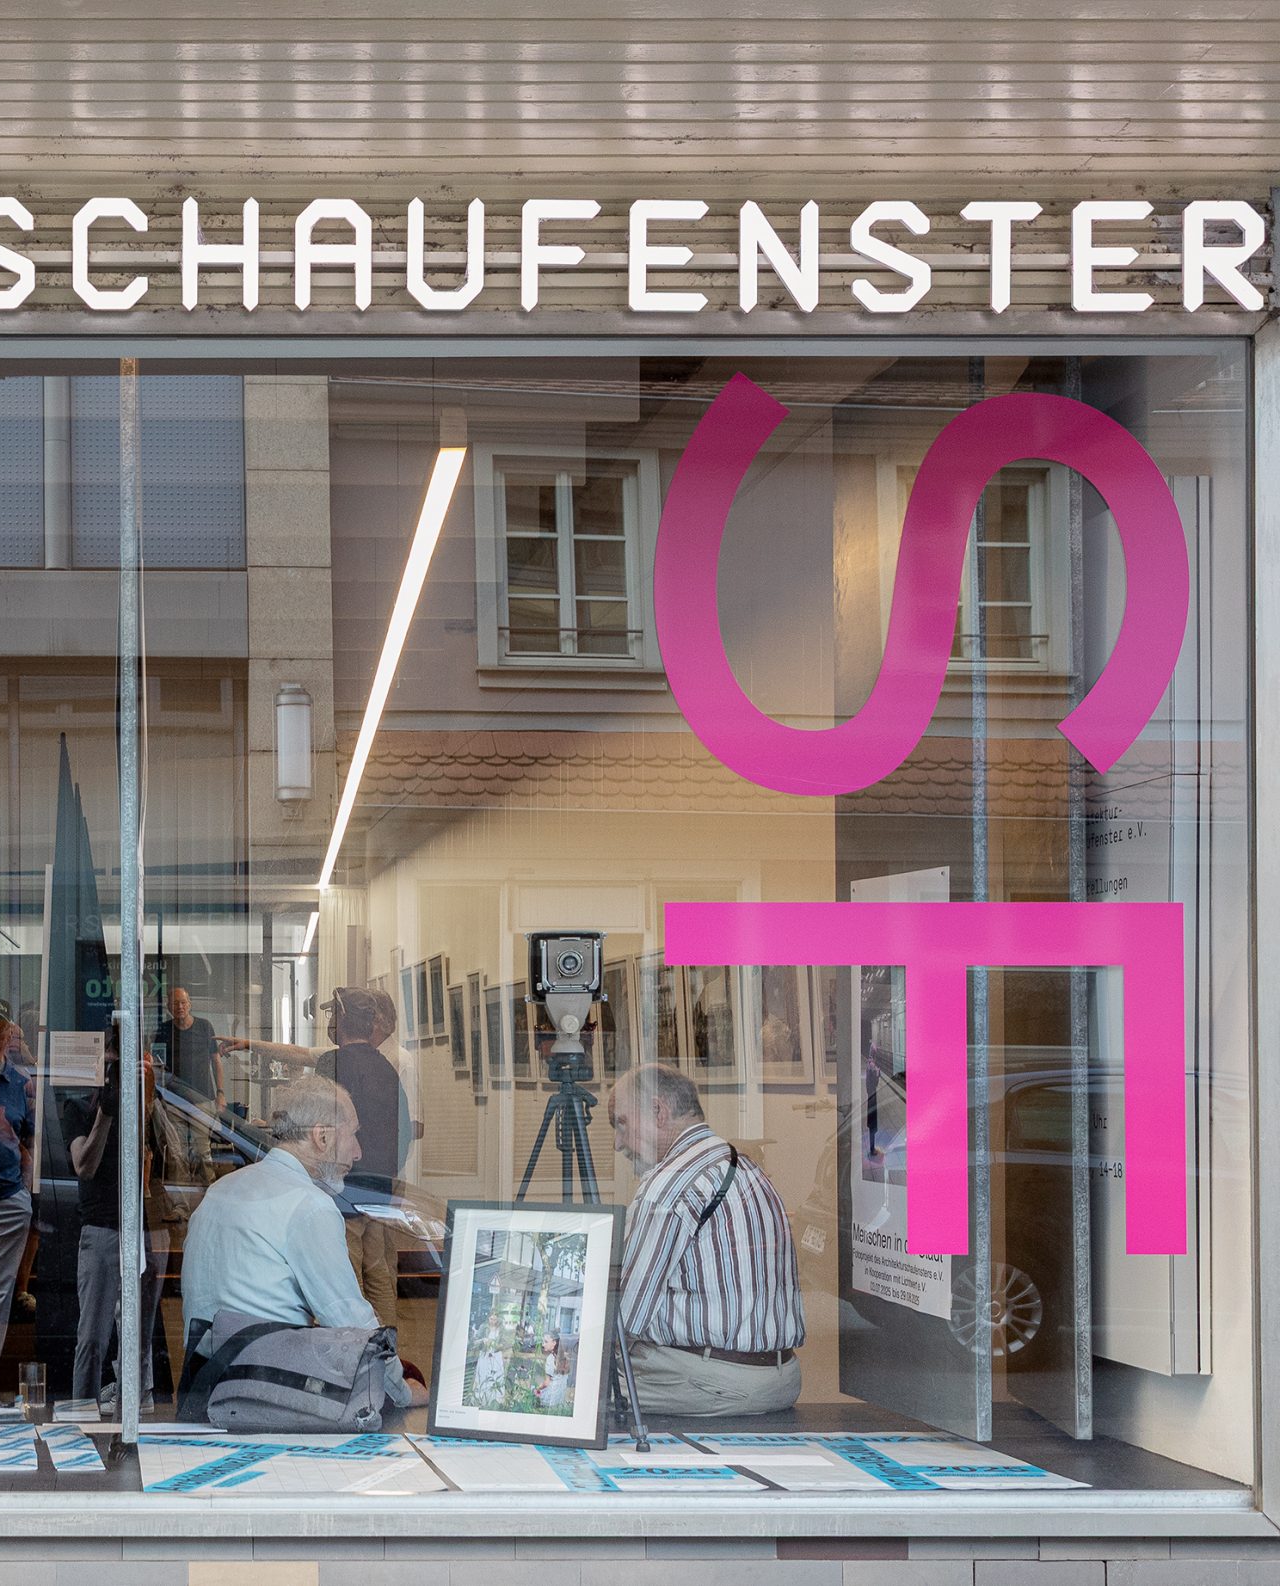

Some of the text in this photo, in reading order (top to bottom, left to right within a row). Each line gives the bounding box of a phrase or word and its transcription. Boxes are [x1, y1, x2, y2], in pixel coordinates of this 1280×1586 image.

[1099, 1161, 1123, 1178] 14-18
[853, 1222, 891, 1251] Menschen
[894, 1232, 903, 1253] in
[622, 1466, 717, 1475] 2025
[927, 1464, 1029, 1474] 2025
